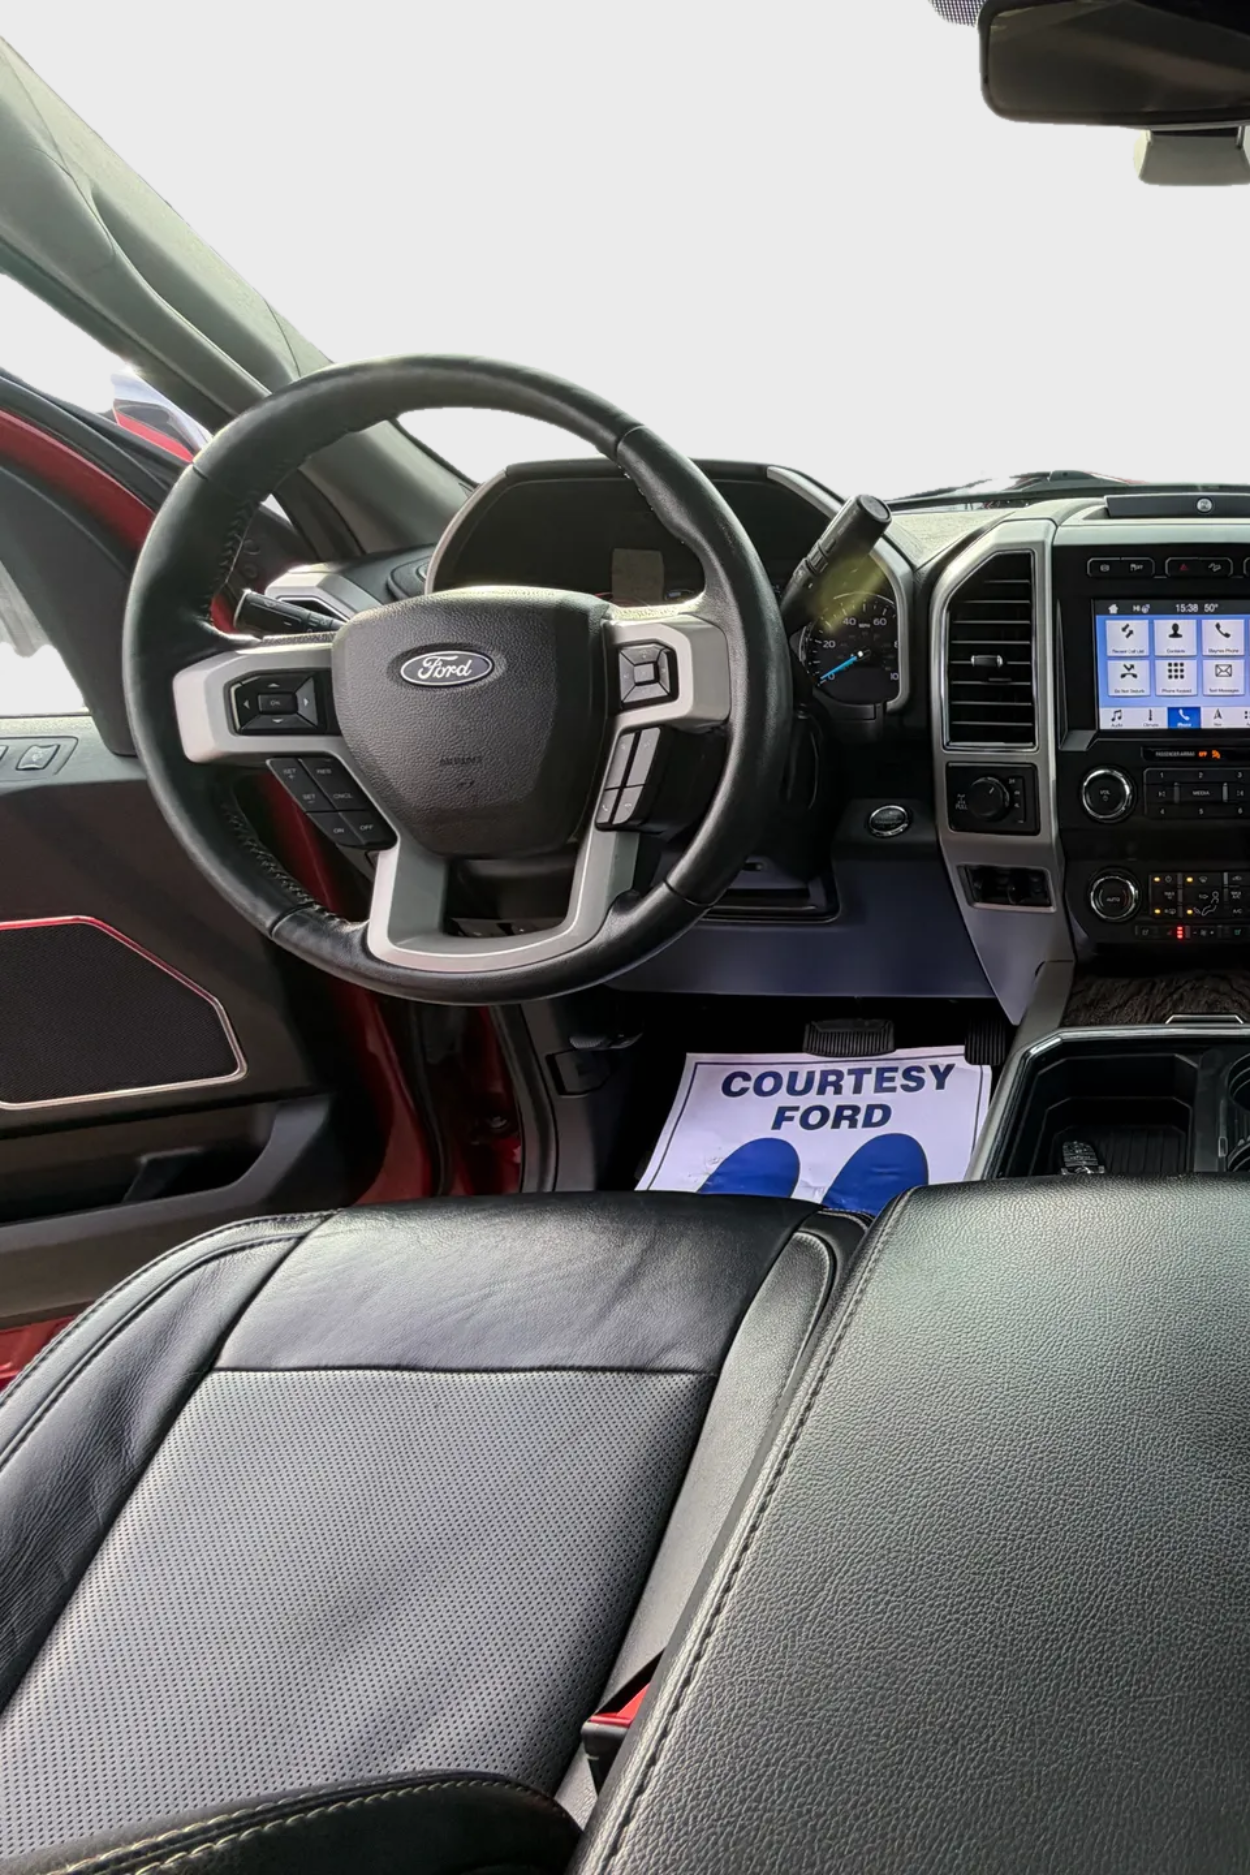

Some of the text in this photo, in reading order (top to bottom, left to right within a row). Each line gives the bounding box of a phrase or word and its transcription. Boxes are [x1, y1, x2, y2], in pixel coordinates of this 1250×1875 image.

[1175, 603, 1199, 613] 15:38
[842, 617, 857, 626] 40
[873, 617, 887, 626] 60
[822, 640, 836, 649] 20
[417, 655, 472, 680] Ford
[720, 1063, 956, 1098] COURTESY
[770, 1103, 893, 1131] FORD
